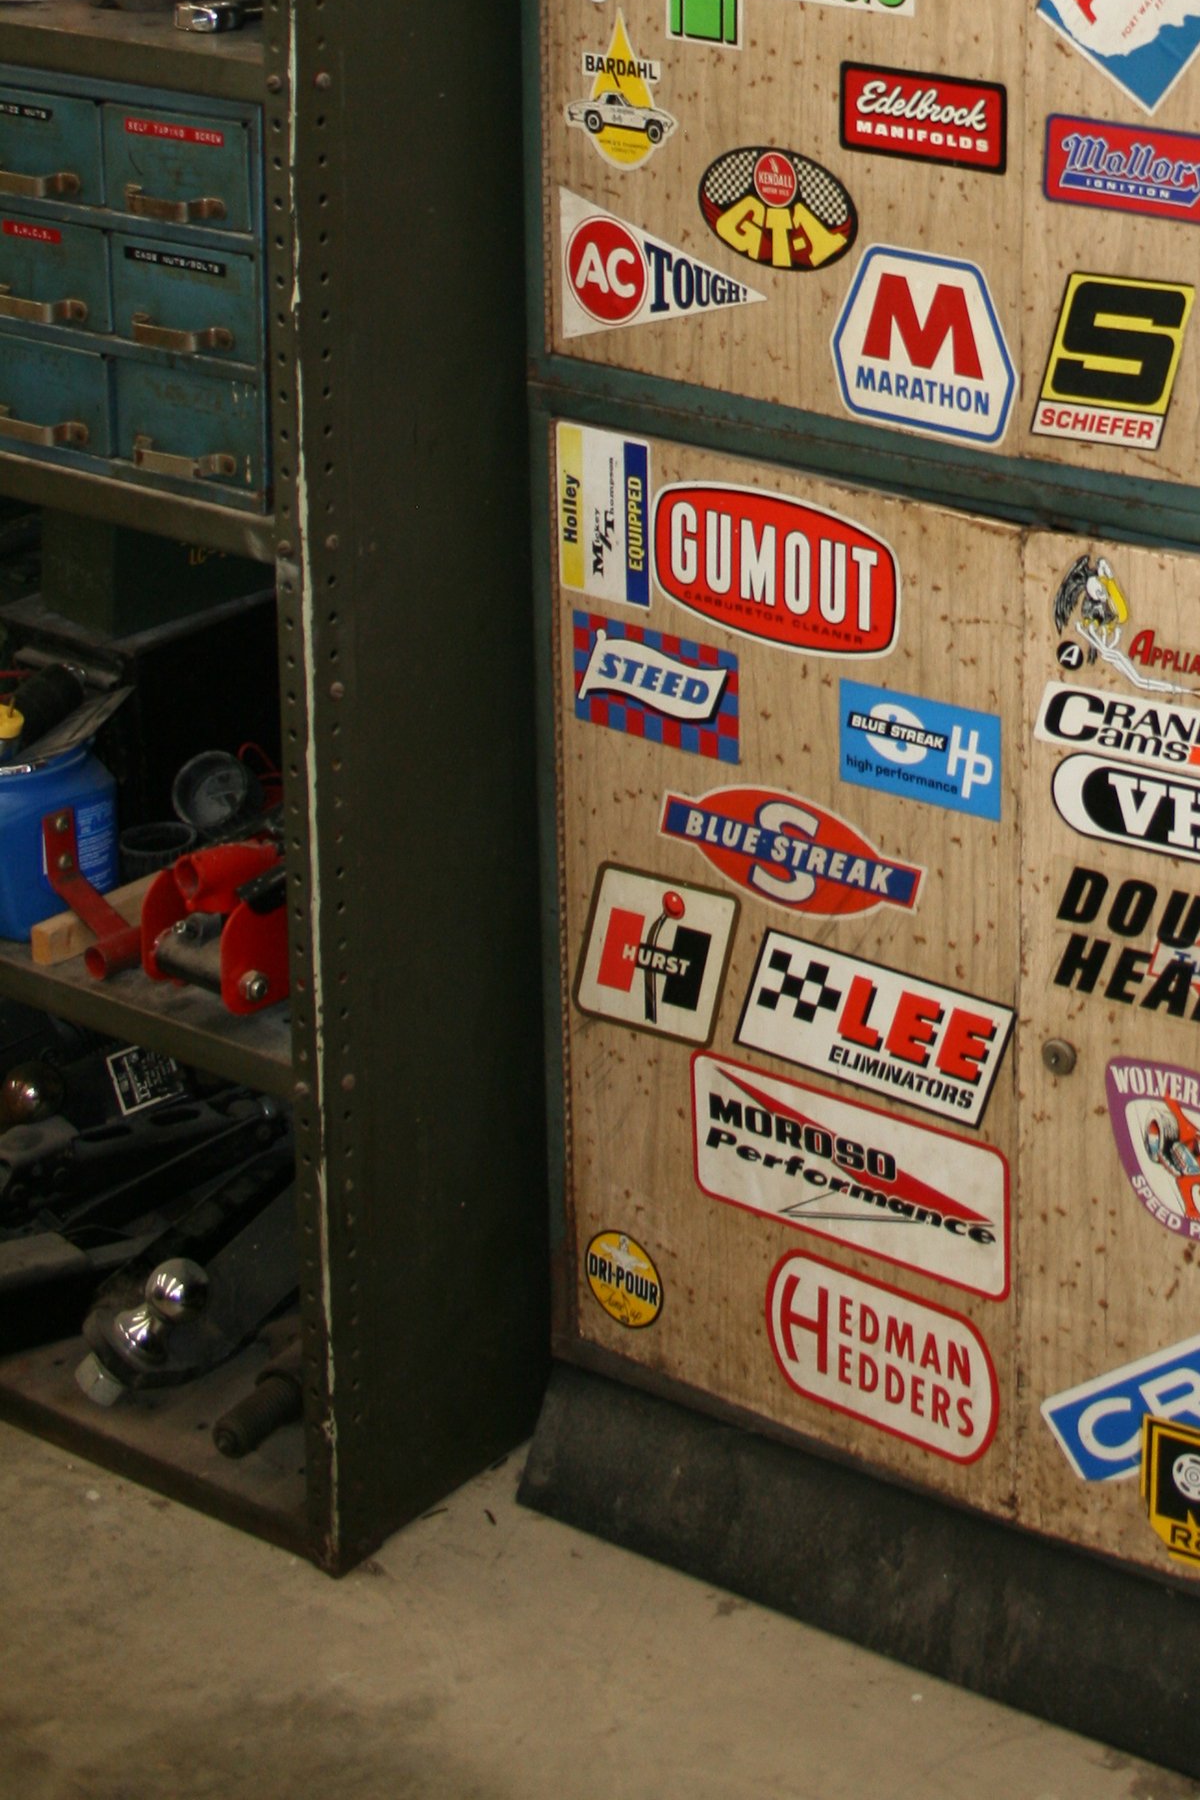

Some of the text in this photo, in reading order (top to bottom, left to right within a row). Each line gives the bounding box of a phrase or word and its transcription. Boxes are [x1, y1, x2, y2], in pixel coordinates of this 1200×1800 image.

[585, 55, 658, 88] BARDAHL
[857, 81, 988, 132] Edelbrock
[195, 130, 222, 144] SCREW
[855, 121, 989, 152] MANIFOLDS
[758, 172, 793, 189] KENDALL
[1085, 178, 1170, 199] IGNITION
[575, 241, 748, 313] AC TOUGH!
[855, 366, 990, 416] MARATHON
[1040, 408, 1154, 440] SCHIEFER
[563, 474, 580, 544] Holley
[628, 476, 643, 572] EQUIPPED
[671, 501, 878, 633] GUMOUT
[683, 590, 864, 646] CARBURETOR CLEANER
[599, 651, 710, 706] STEED
[851, 714, 945, 750] BLUE STREAK
[846, 755, 958, 795] high performance
[684, 810, 895, 894] BLUE STREAK
[622, 943, 691, 977] HURST
[836, 974, 994, 1086] LEE
[828, 1044, 975, 1110] ELIMINATORS
[708, 1093, 897, 1182] MOROSO
[705, 1126, 997, 1247] Performance
[1131, 1174, 1183, 1232] SPEED
[588, 1254, 660, 1306] DRI-POWR
[779, 1274, 972, 1388] HEDMAN
